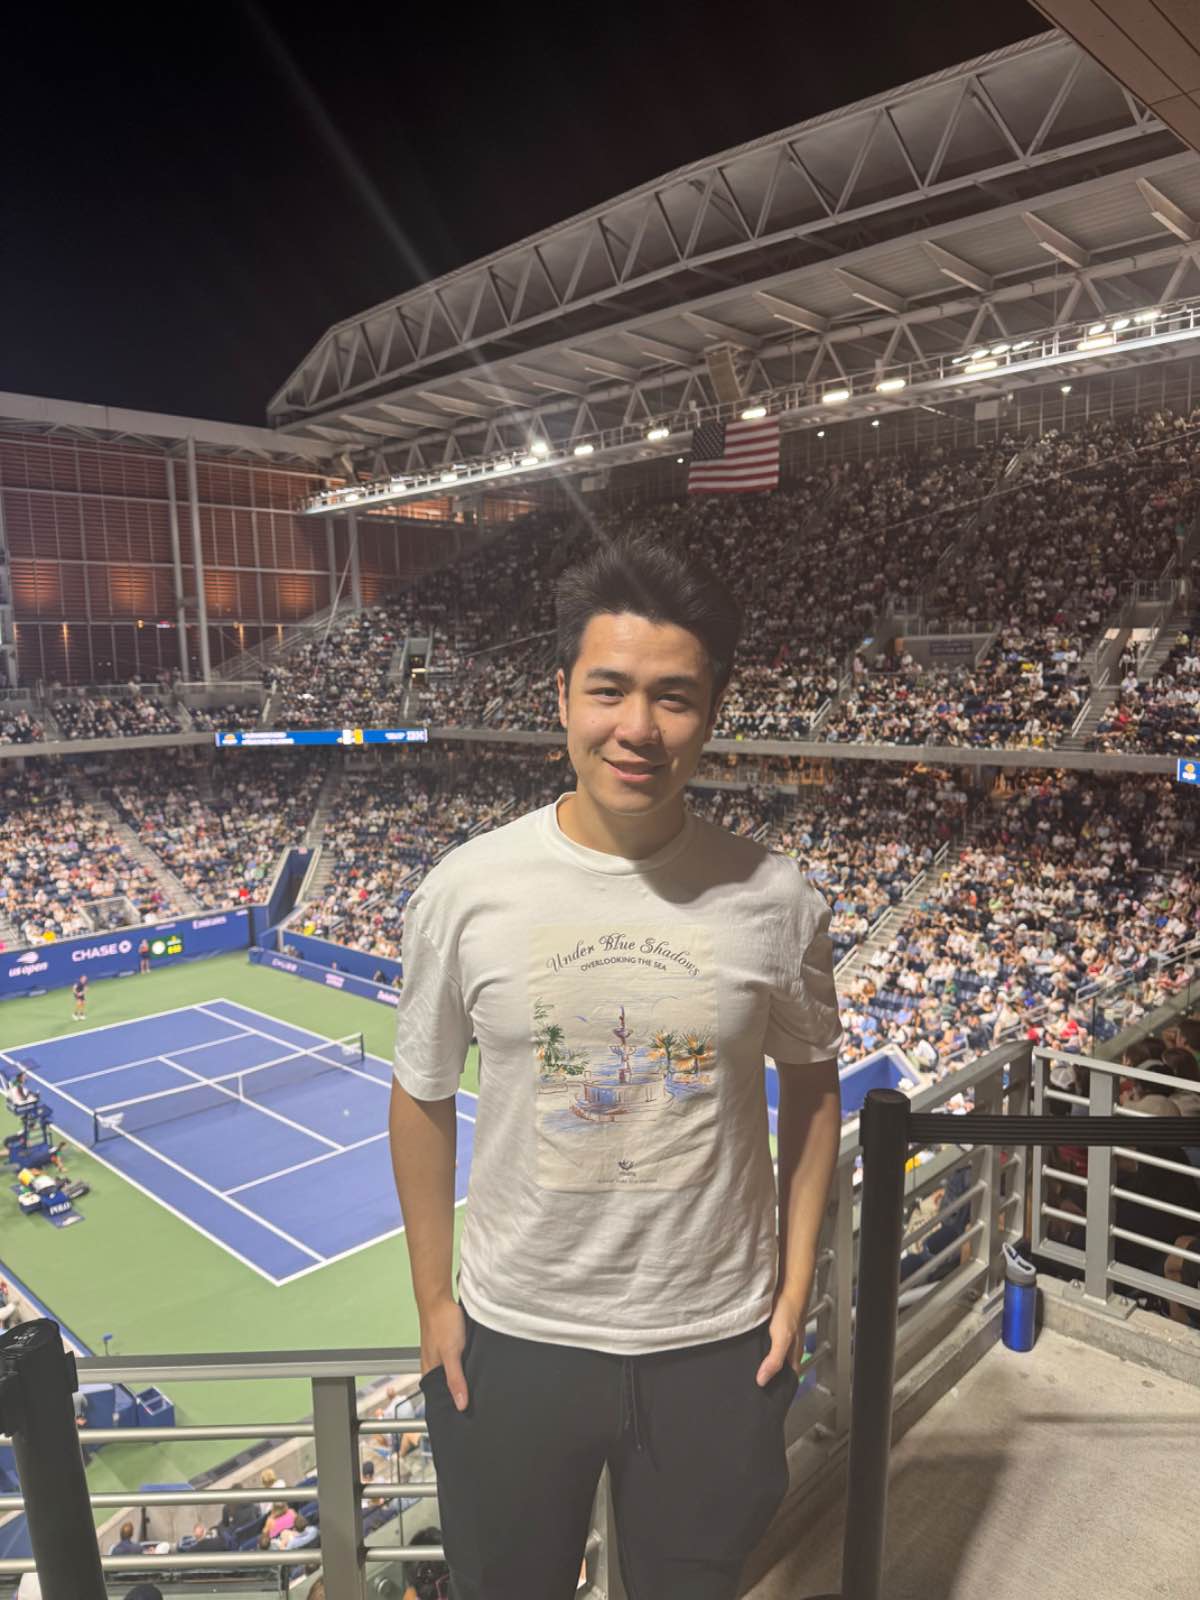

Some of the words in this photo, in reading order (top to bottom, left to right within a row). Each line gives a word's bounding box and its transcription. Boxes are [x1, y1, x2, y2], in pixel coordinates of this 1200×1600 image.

[72, 943, 117, 962] CHASE
[546, 939, 595, 972] Under
[599, 933, 635, 951] Blue
[640, 937, 700, 976] Shadows
[22, 962, 48, 975] open
[581, 956, 636, 971] OVERLOOKING
[638, 957, 651, 966] THE
[654, 961, 667, 971] SEA
